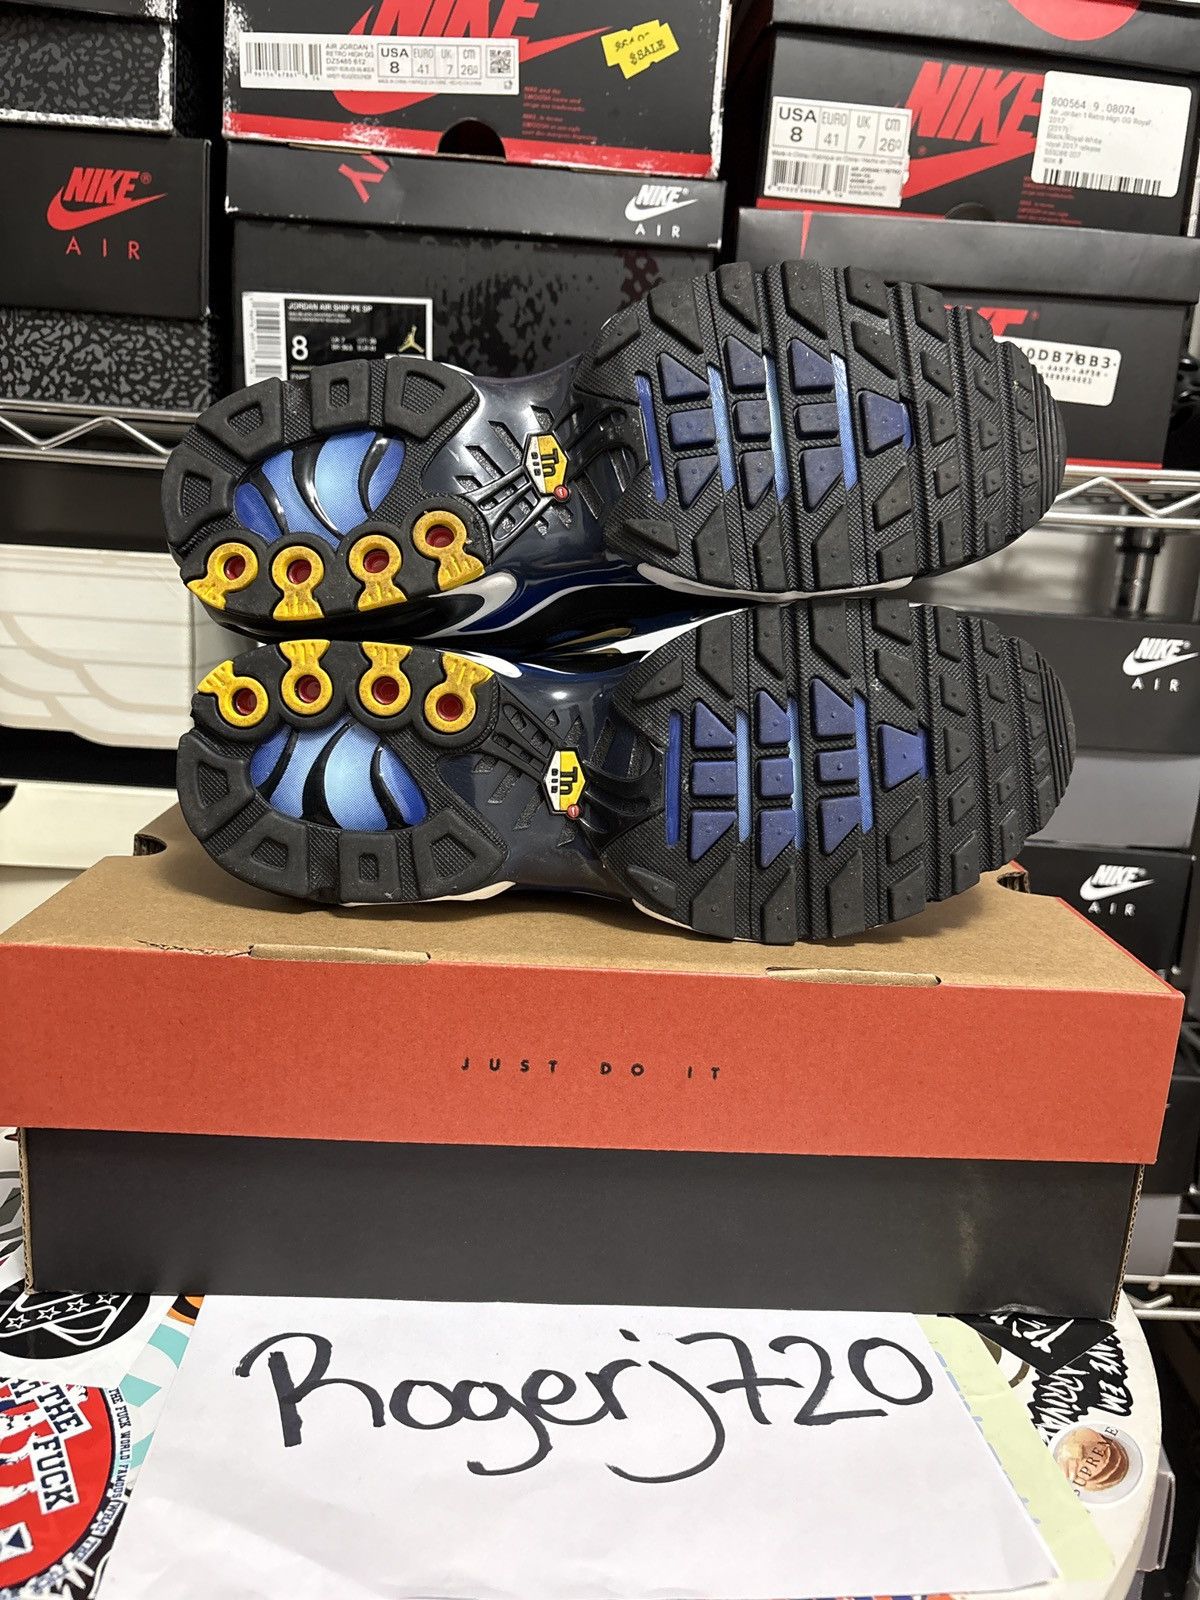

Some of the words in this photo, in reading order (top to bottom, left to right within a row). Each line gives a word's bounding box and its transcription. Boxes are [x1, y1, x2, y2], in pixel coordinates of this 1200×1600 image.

[380, 47, 409, 58] USA
[413, 48, 434, 59] EURO
[440, 49, 453, 59] UK
[389, 61, 400, 74] 8
[417, 64, 430, 74] 41
[446, 64, 453, 75] 7
[905, 60, 1047, 146] NIKE
[1051, 97, 1086, 110] 800564
[779, 106, 817, 123] USA
[821, 111, 848, 127] EURO
[856, 114, 872, 129] UK
[790, 126, 803, 143] 8
[823, 132, 840, 147] 41
[857, 135, 867, 150] 7
[63, 167, 141, 204] NIKE
[635, 184, 682, 206] NIKE
[635, 223, 681, 238] AIR
[65, 235, 141, 260] AIR
[291, 335, 309, 361] 8
[541, 448, 560, 478] Tn
[1134, 637, 1185, 660] NIKE
[1131, 676, 1179, 692] AIR
[560, 766, 578, 795] Tn
[1091, 864, 1140, 886] NIKE
[1088, 901, 1136, 917] AIR
[460, 1057, 558, 1073] JUST
[599, 1061, 645, 1077] DO
[686, 1065, 721, 1081] IT
[109, 1387, 123, 1405] THE
[234, 1328, 935, 1484] Rogerj720
[37, 1384, 84, 1434] THE
[115, 1405, 132, 1429] FUCK
[119, 1431, 131, 1461] WORLD
[32, 1435, 75, 1511] FUCK
[112, 1464, 129, 1499] FAMOUS
